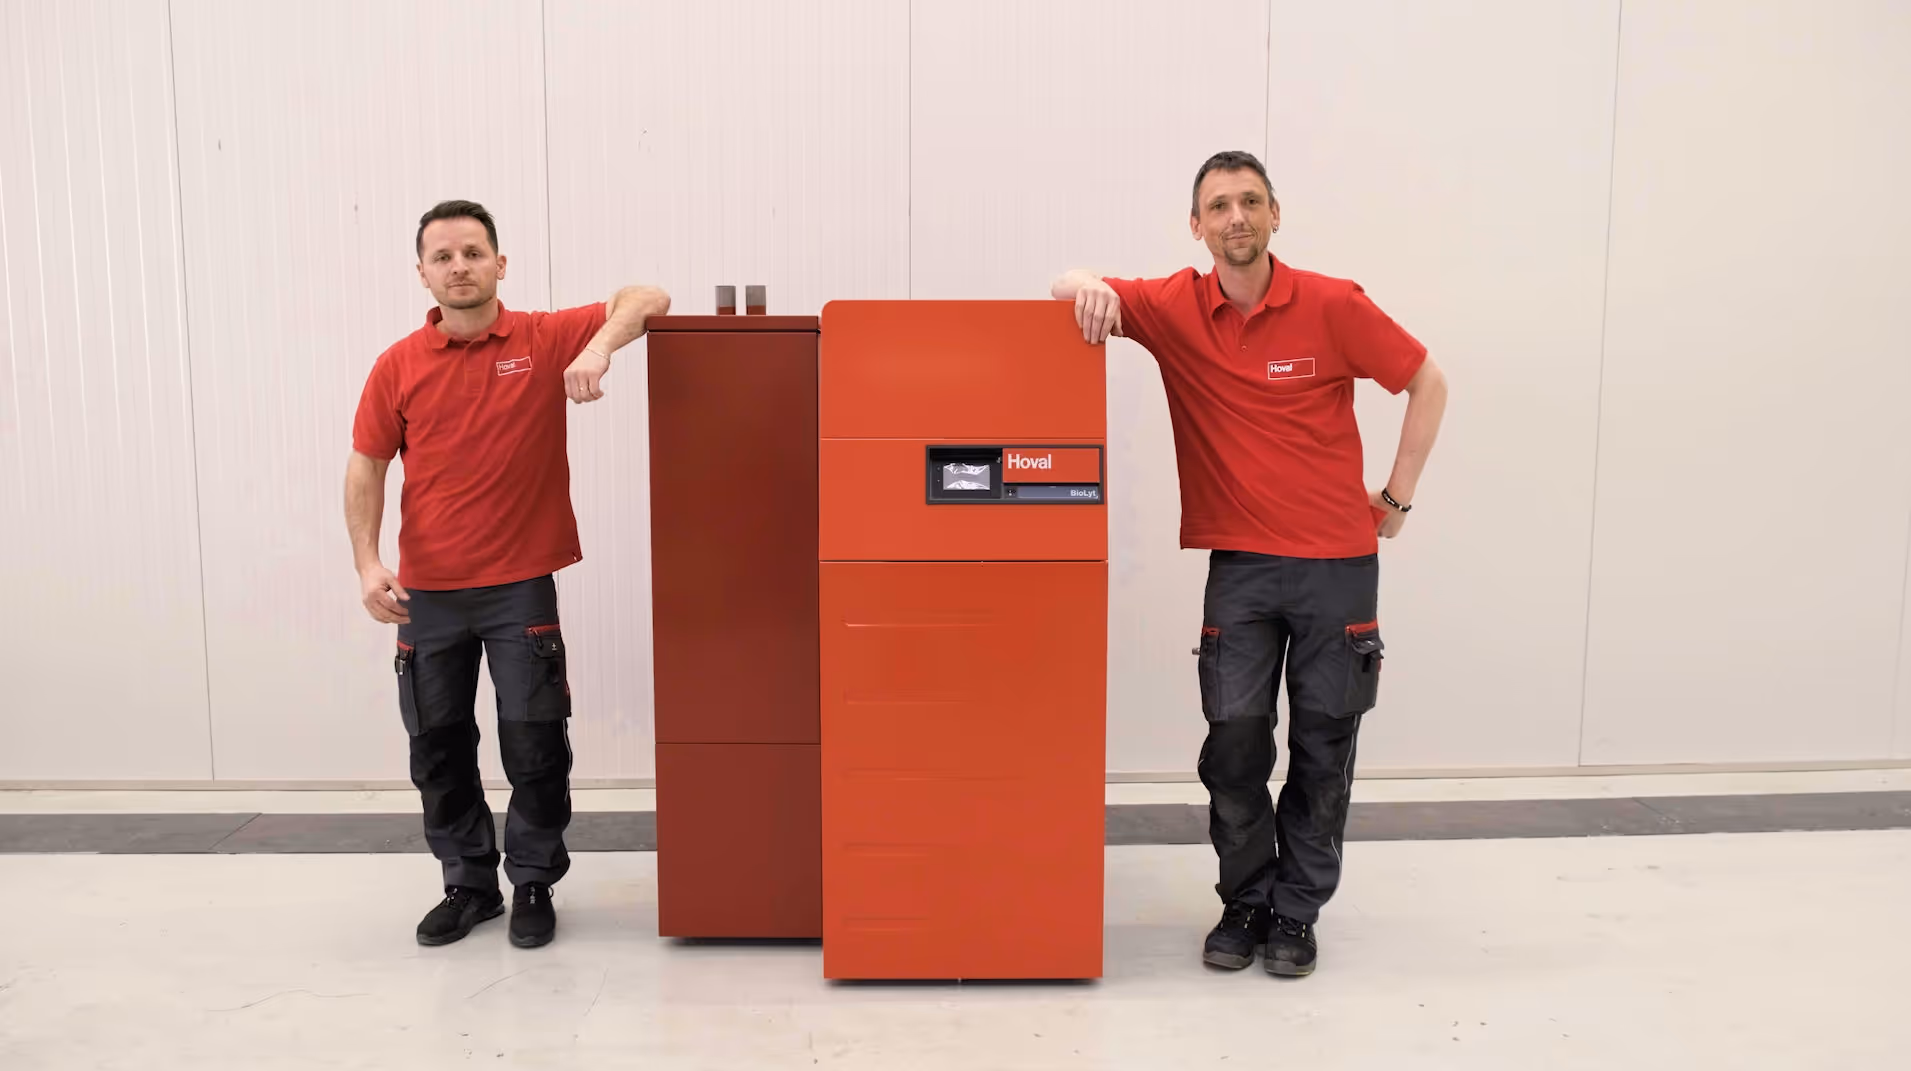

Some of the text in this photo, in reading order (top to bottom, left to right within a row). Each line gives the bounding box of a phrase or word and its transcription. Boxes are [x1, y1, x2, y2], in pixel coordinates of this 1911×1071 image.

[1270, 363, 1292, 372] Hoval
[1007, 453, 1052, 469] Hoval
[1070, 489, 1096, 498] BioLyt
